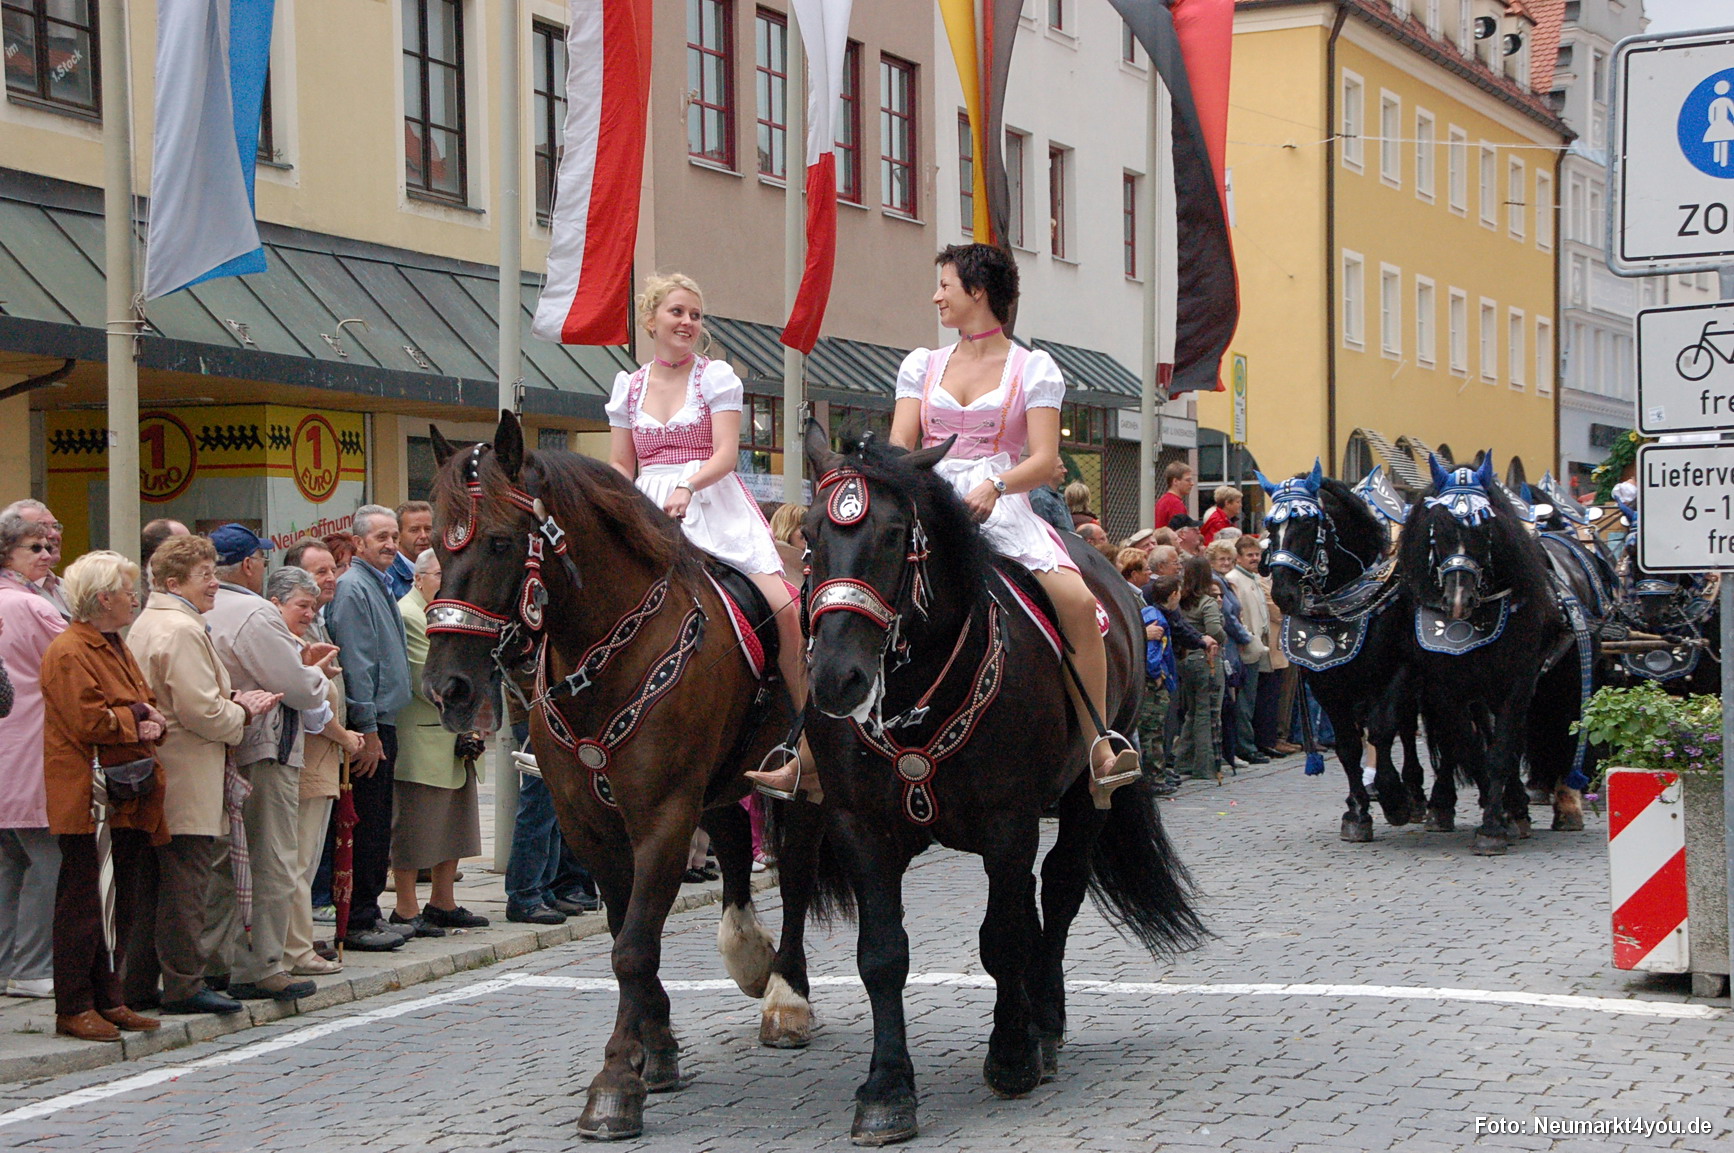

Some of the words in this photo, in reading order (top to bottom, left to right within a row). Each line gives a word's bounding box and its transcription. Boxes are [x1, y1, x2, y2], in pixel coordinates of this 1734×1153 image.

[5, 43, 19, 58] im
[52, 49, 83, 83] 1.Stock
[1677, 202, 1734, 237] ZO
[140, 424, 165, 469] 1
[306, 425, 321, 469] 1
[301, 466, 332, 492] EURO
